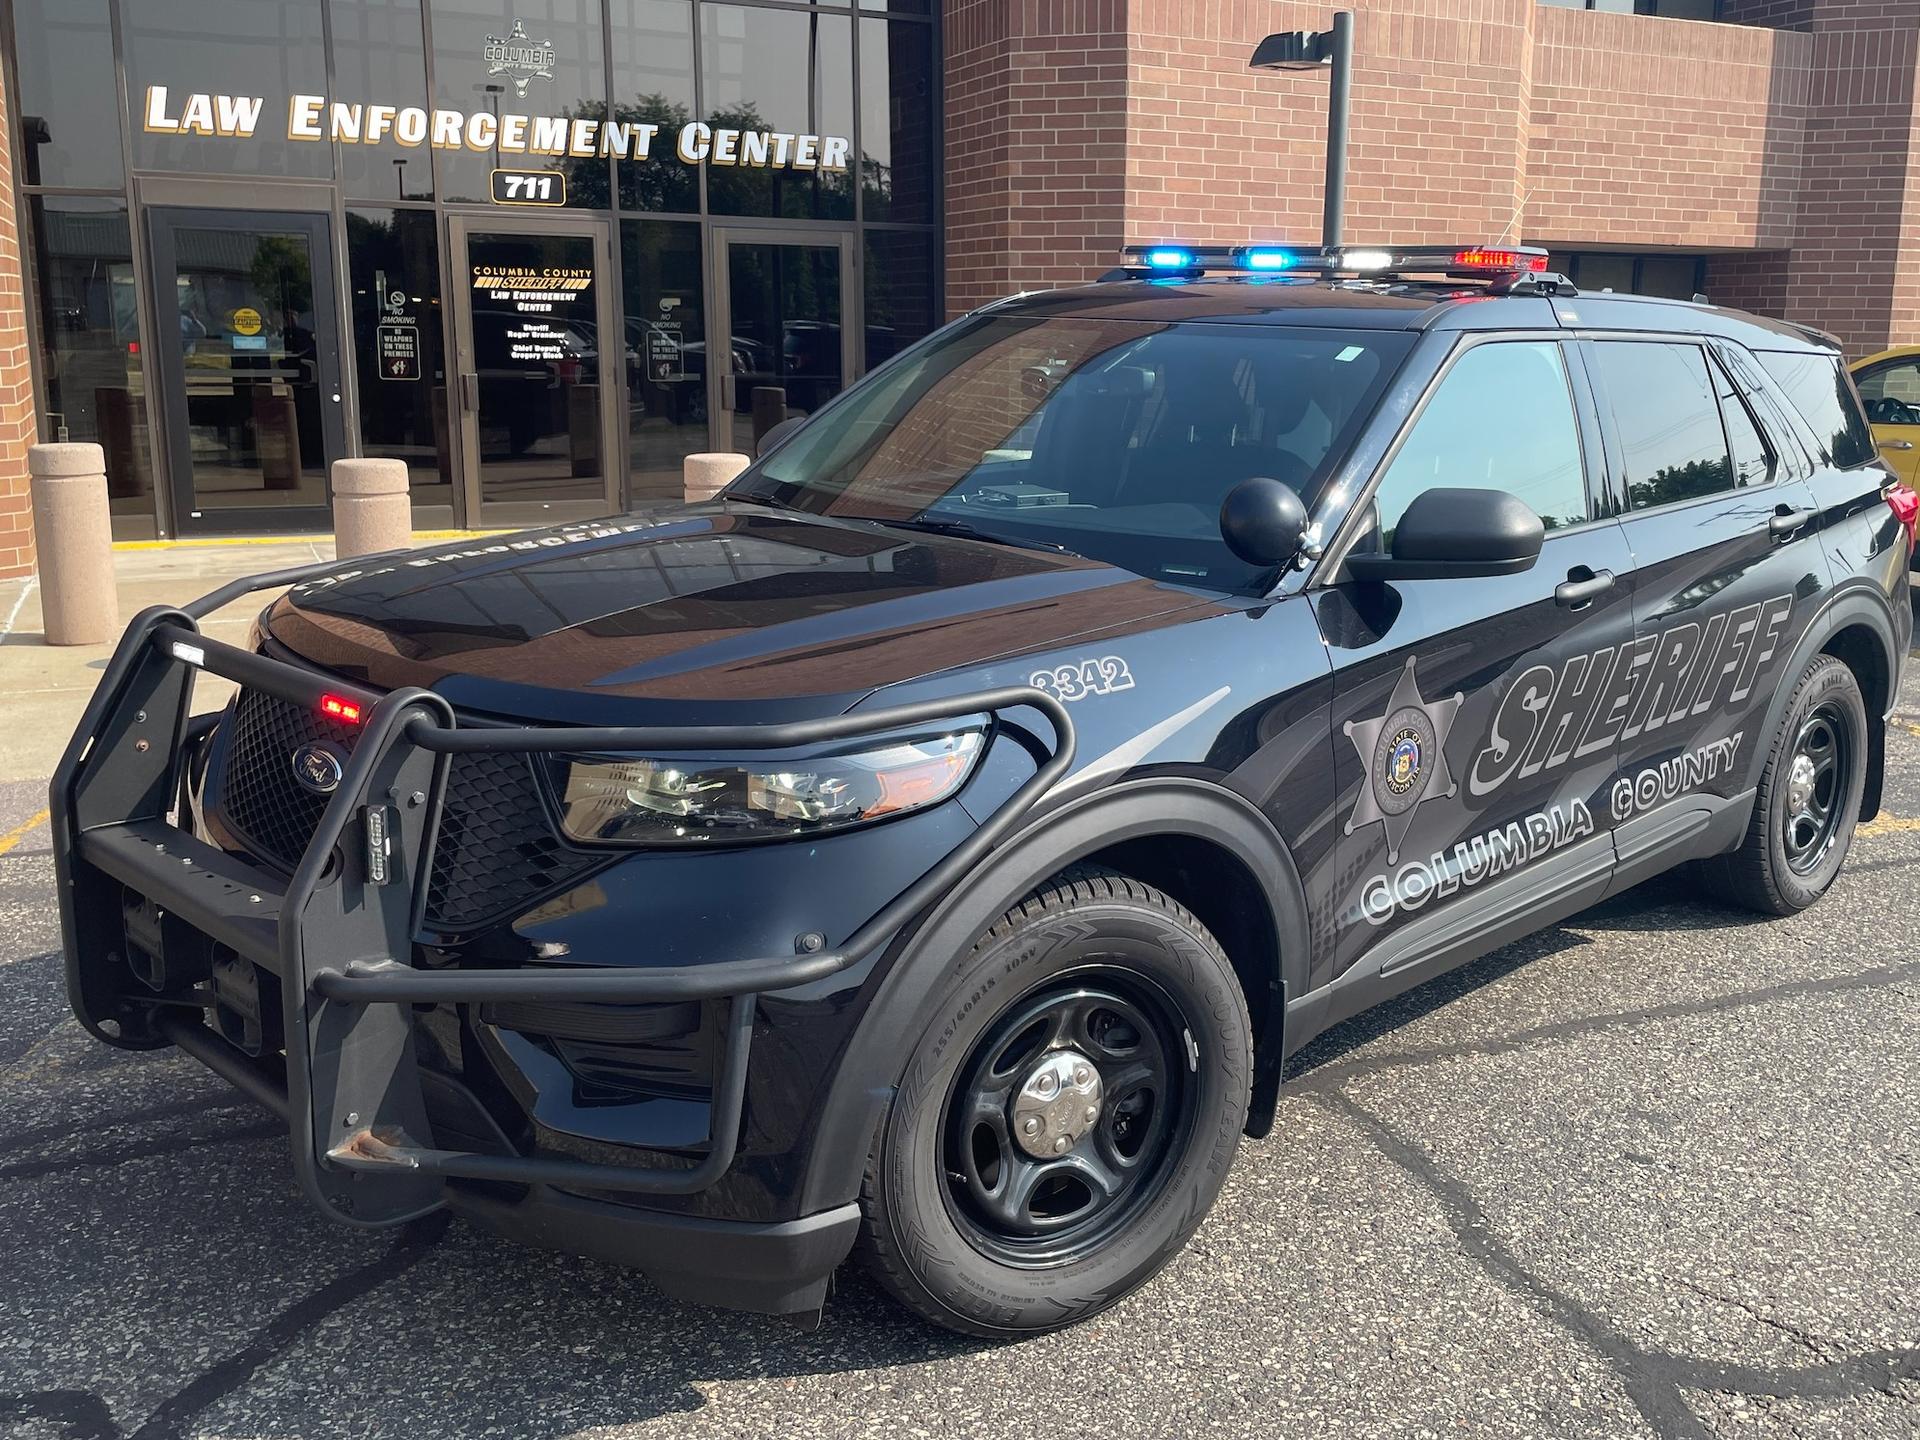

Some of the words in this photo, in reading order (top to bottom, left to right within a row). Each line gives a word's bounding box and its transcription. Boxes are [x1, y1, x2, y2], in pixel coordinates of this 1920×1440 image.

[484, 46, 555, 66] COLUMBIA
[143, 85, 264, 138] LAW
[287, 93, 660, 162] ENFORCEMENT
[677, 120, 851, 172] CENTER
[503, 174, 552, 202] 711
[473, 266, 536, 276] COLUMBIA
[543, 268, 592, 278] COUNTY
[501, 277, 565, 289] SHERIFF
[490, 290, 510, 300] LAW
[513, 290, 577, 301] ENFORCEMENT
[517, 302, 552, 312] CENTER
[381, 316, 416, 324] SMOKING
[523, 324, 549, 332] Sheriff
[660, 313, 671, 321] NO
[1029, 655, 1136, 702] 3342
[1469, 593, 1794, 796] SHERIFF
[1375, 713, 1408, 771] COLUMBIA
[1411, 713, 1433, 756] COUNTY
[1388, 730, 1408, 754] STATE
[1412, 733, 1422, 745] OF
[1386, 766, 1420, 794] WISCONSIN
[1359, 797, 1595, 926] COLUMBIA
[1610, 731, 1744, 821] COUNTY
[932, 977, 997, 1058] 255/60R18
